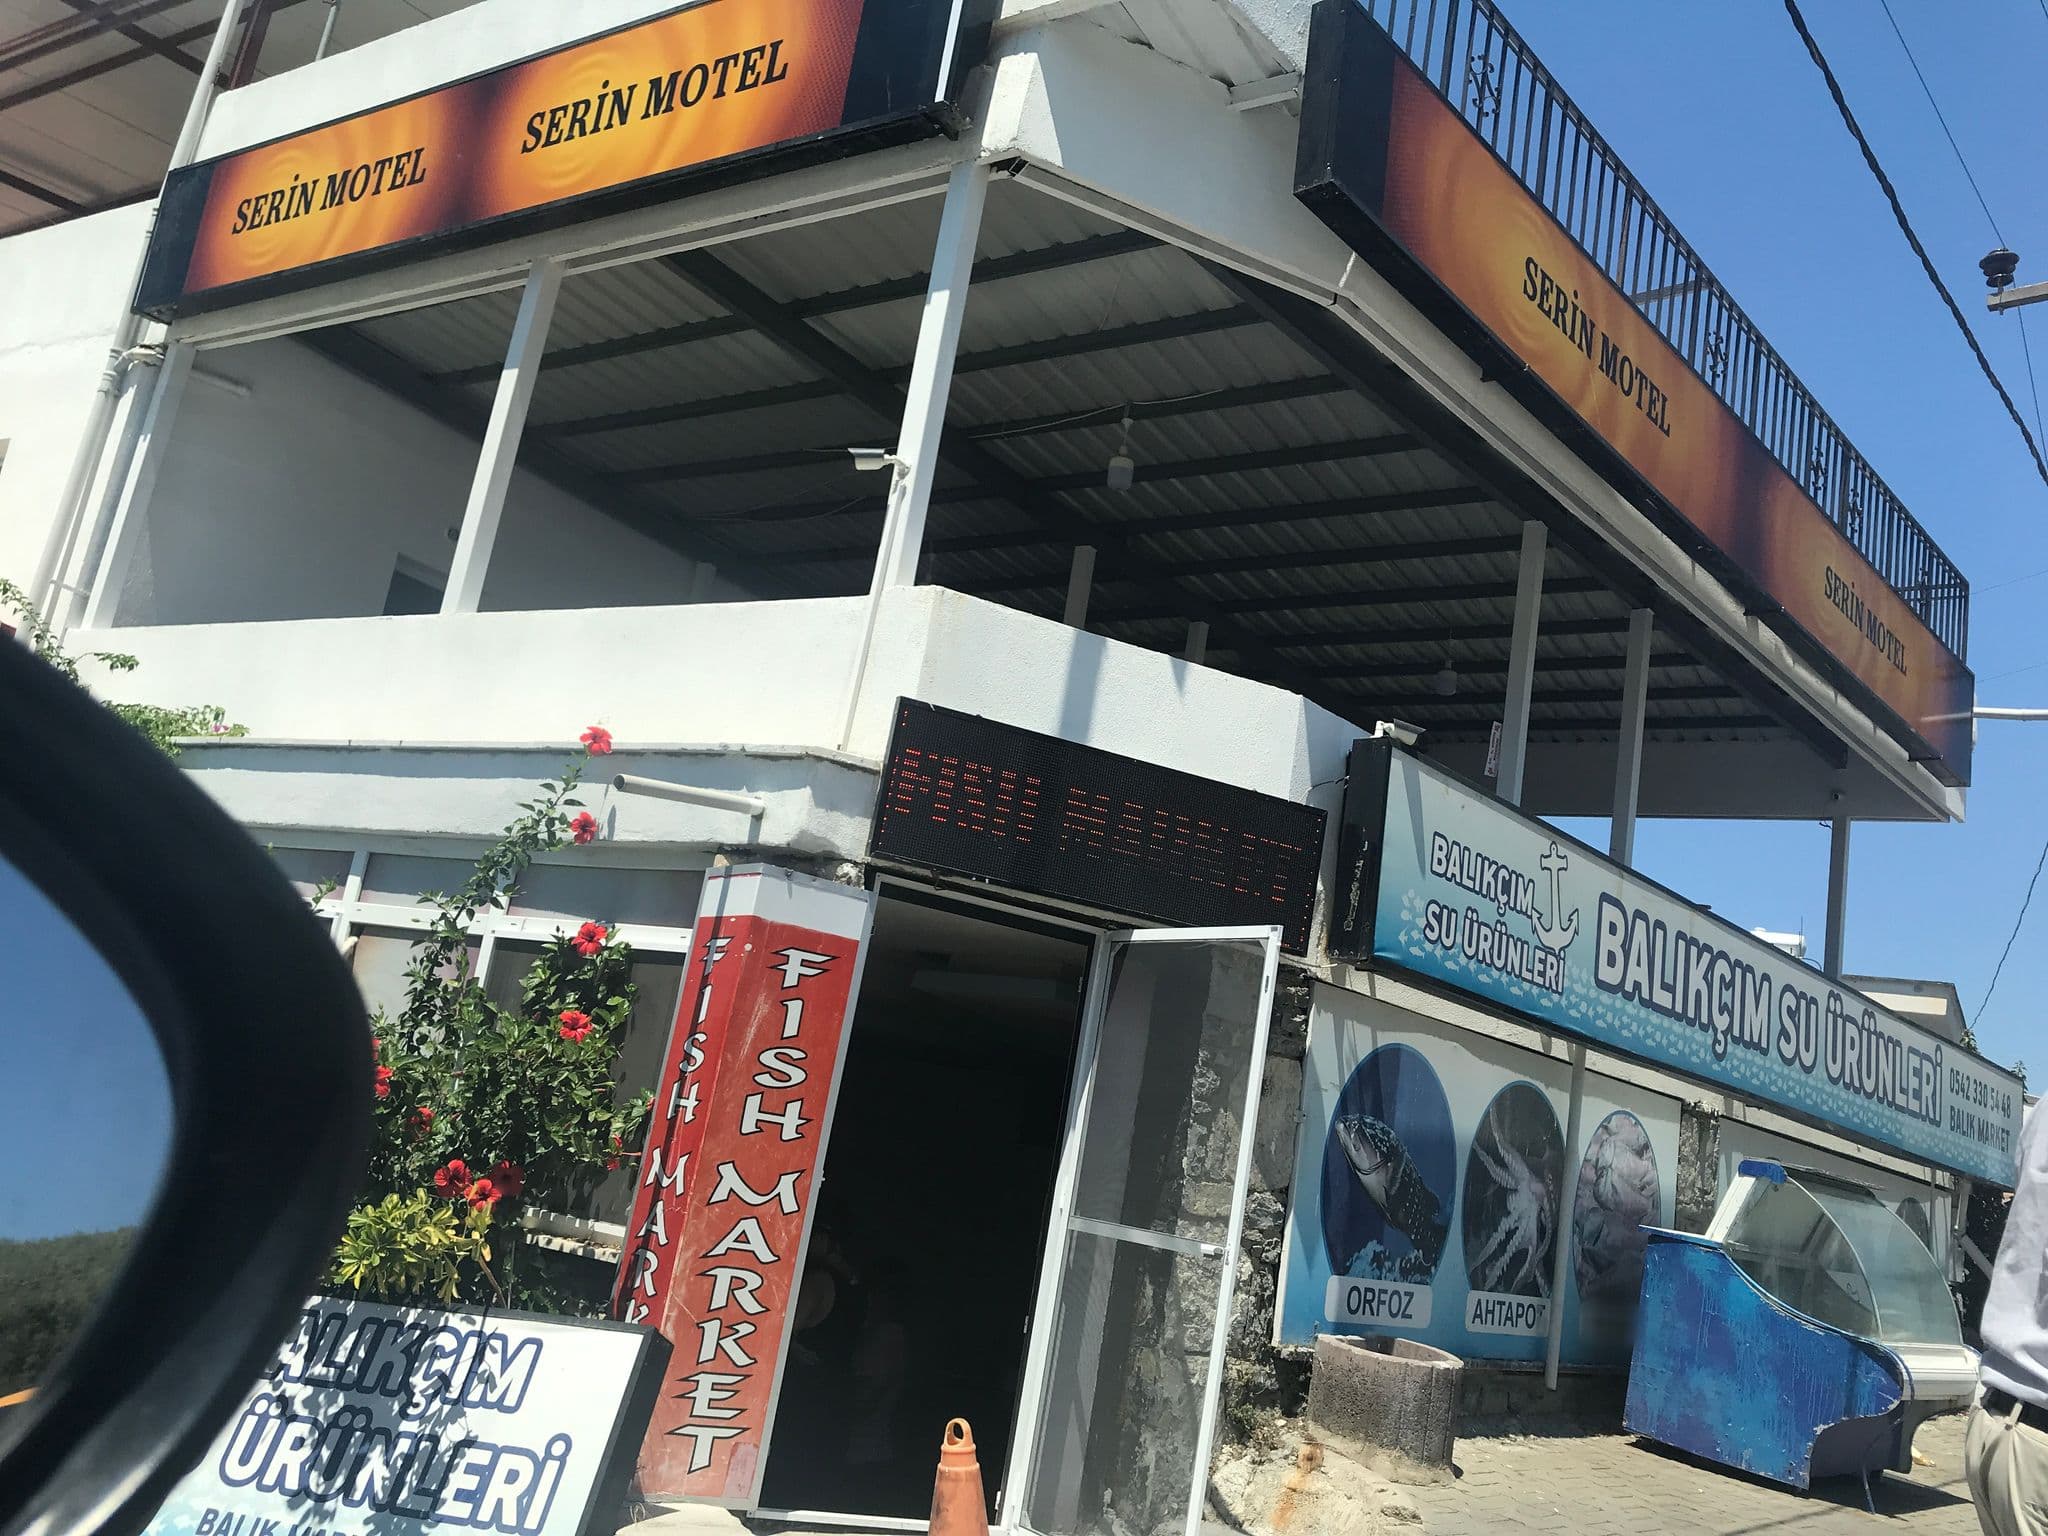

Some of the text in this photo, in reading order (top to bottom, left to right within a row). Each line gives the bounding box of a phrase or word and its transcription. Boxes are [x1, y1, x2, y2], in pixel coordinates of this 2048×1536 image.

[521, 40, 789, 154] SERİN MOTEL
[232, 148, 427, 235] SERİN MOTEL
[1522, 255, 1672, 438] SERİN MOTEL
[1824, 565, 1908, 676] SERİN MOTEL
[1431, 831, 1536, 918] BALIKÇIM
[1423, 899, 1567, 996] SU ÜRÜNLERİ
[1595, 892, 1943, 1128] BALIKÇIM SU ÜRÜNLERİ
[624, 935, 734, 1326] FISH MARK
[1949, 1067, 1970, 1102] 0542
[1973, 1078, 1988, 1109] 330
[1950, 1105, 2010, 1153] BALIK MARKET
[665, 946, 841, 1475] FISH MARKET
[1346, 1284, 1415, 1320] ORFOZ
[262, 1309, 544, 1420] ALIKÇIM
[218, 1394, 573, 1536] ÜRÜNLERİ
